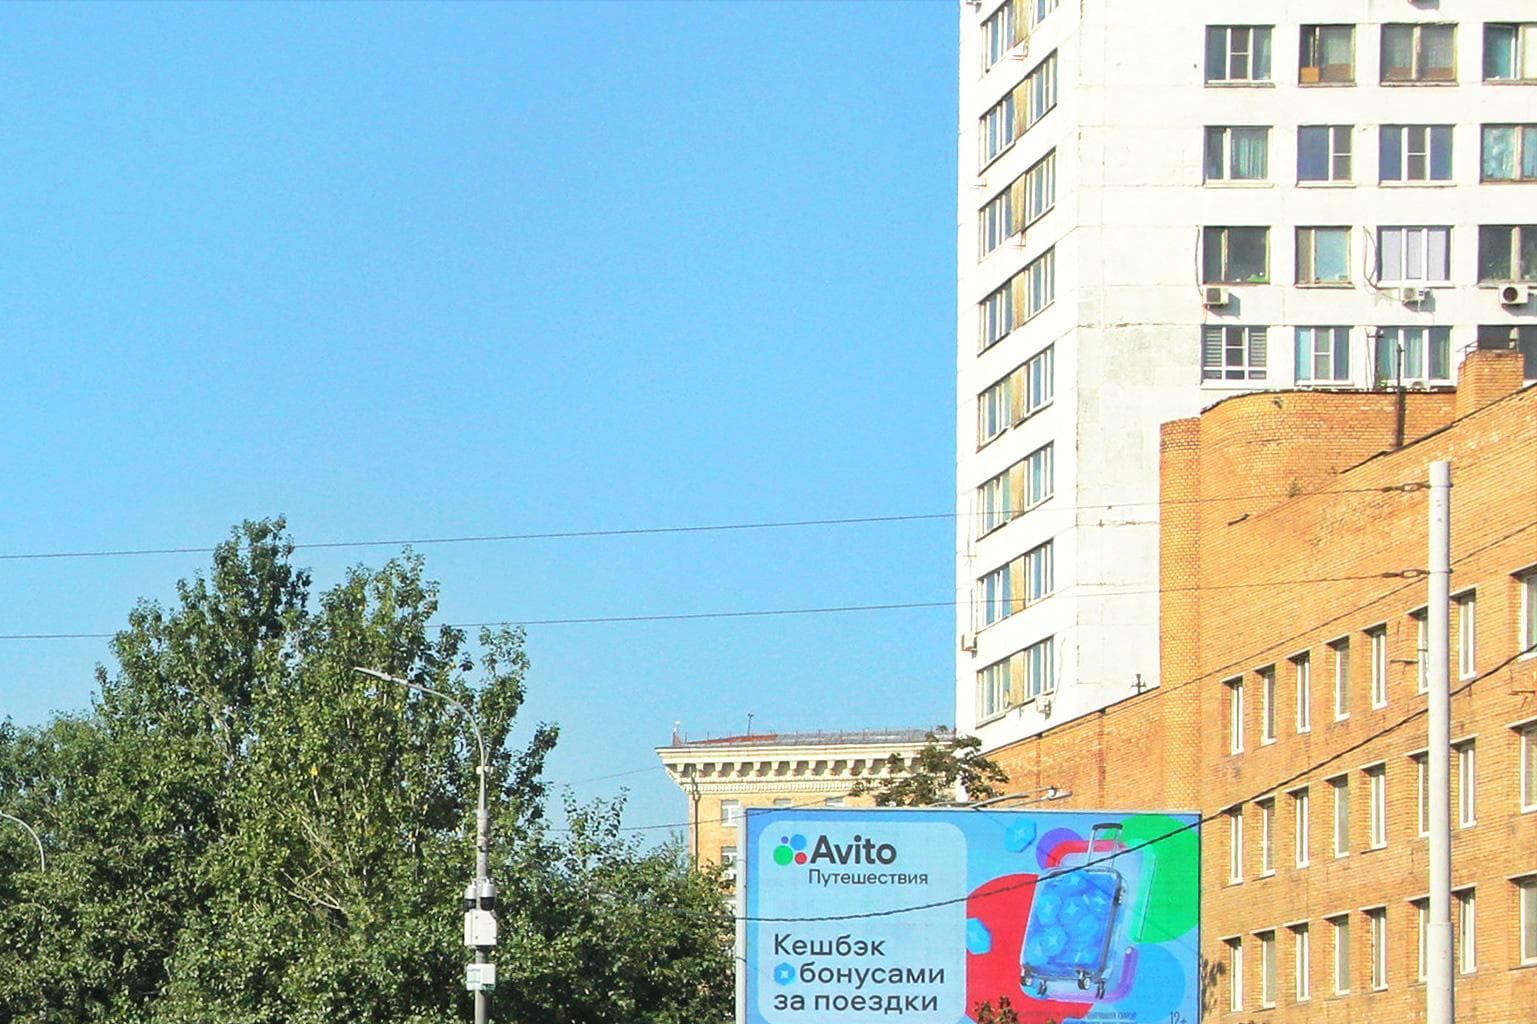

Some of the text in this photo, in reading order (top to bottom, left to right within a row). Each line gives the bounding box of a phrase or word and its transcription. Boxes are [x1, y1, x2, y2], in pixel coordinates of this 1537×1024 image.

[810, 834, 897, 866] Avito
[808, 868, 928, 888] Путешествия
[773, 933, 886, 958] Кешбэк
[799, 963, 945, 989] бонусами
[773, 994, 939, 1016] за поездки
